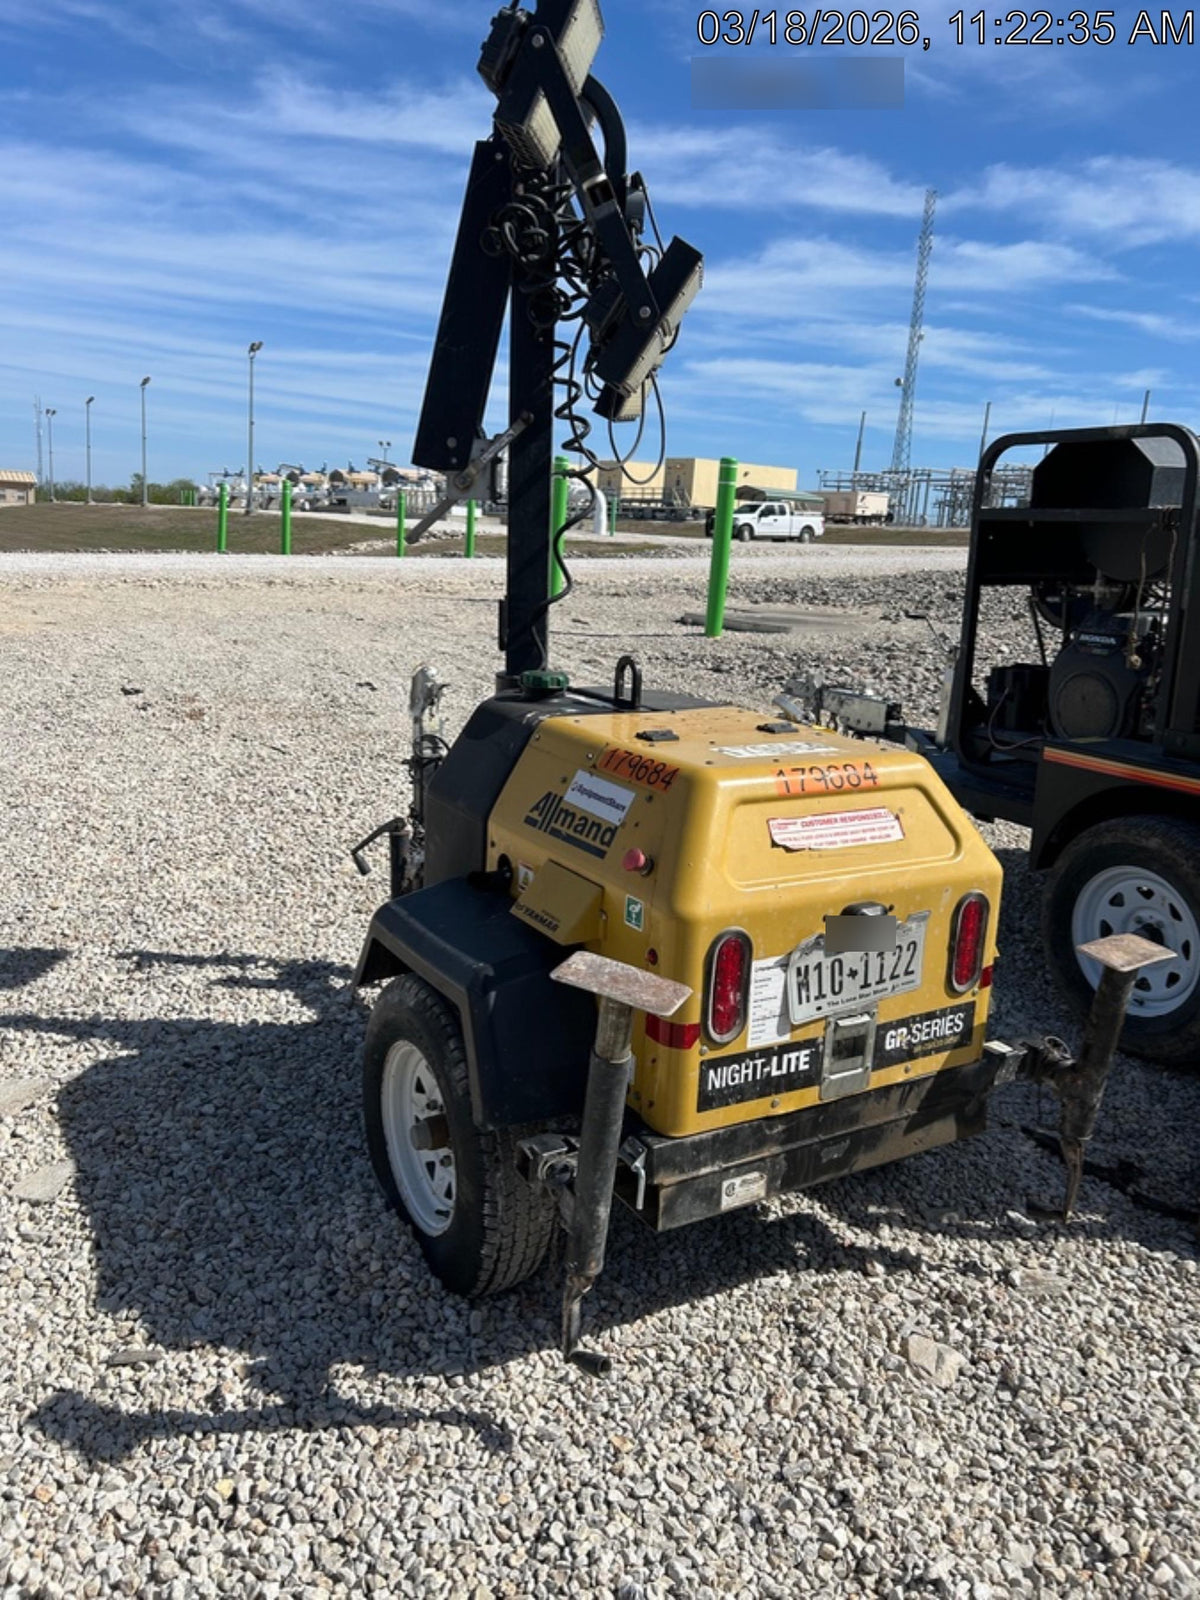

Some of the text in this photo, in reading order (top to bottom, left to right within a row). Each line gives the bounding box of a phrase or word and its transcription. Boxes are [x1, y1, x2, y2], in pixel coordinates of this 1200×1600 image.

[603, 748, 680, 791] 179684
[776, 762, 878, 794] 179684
[530, 790, 618, 848] Allmand
[708, 1049, 811, 1091] NIGHT-LITE
